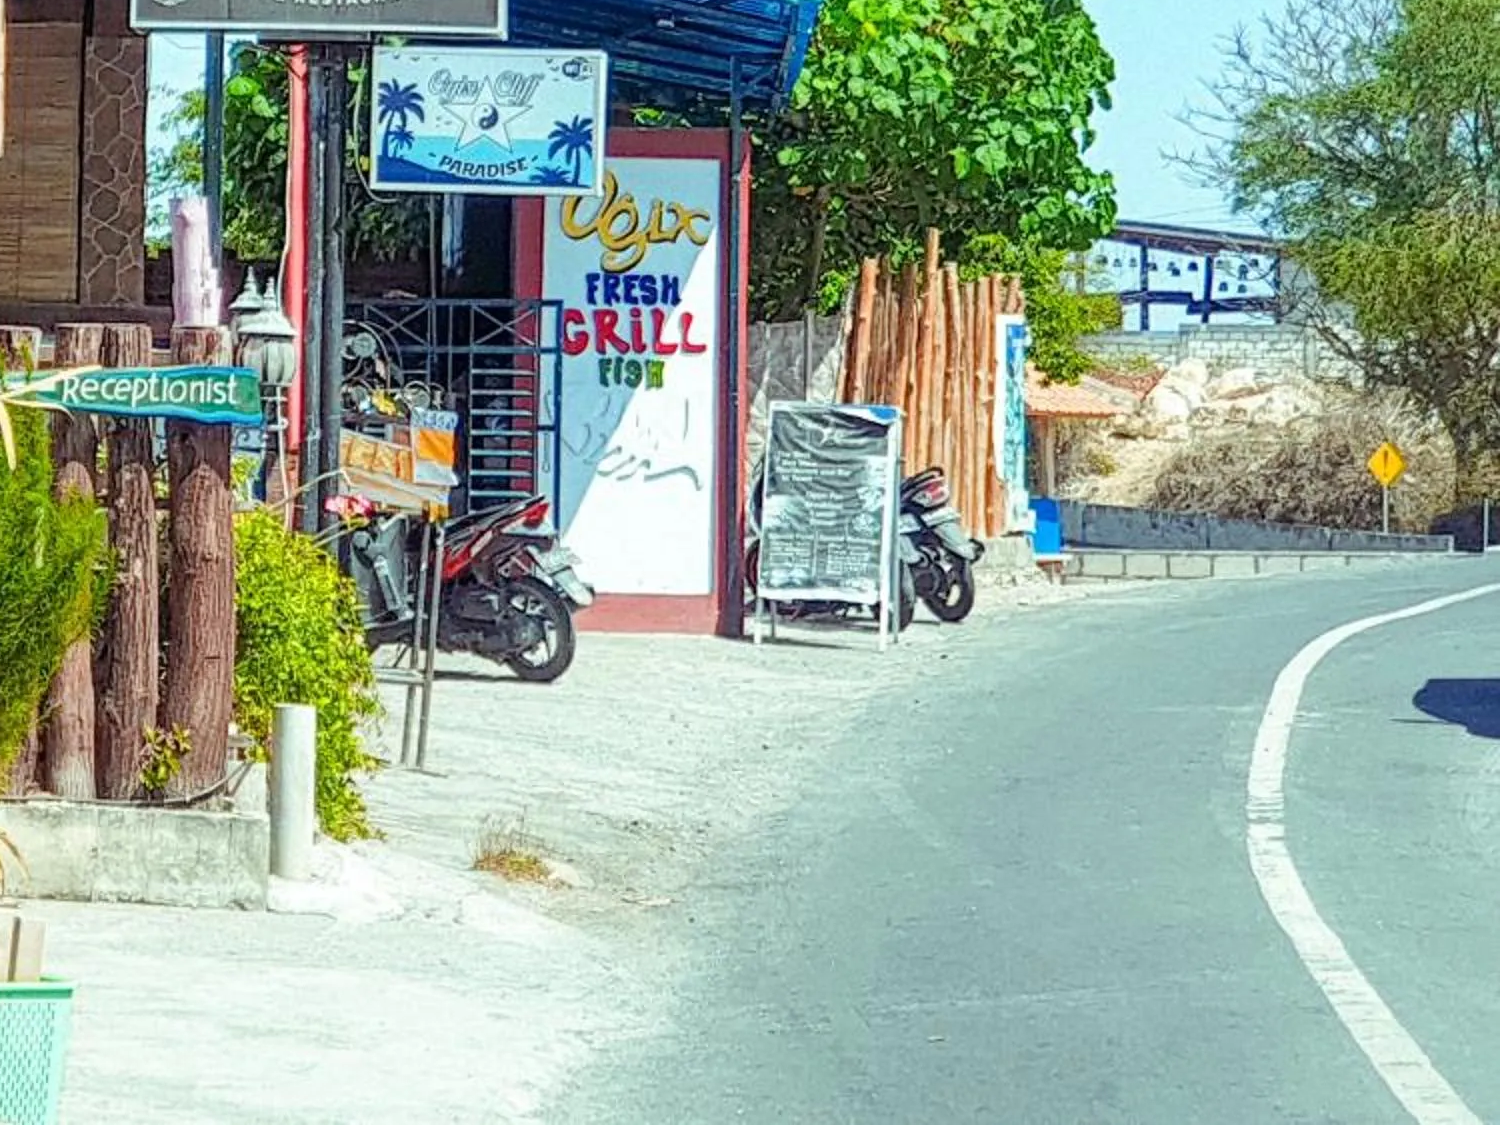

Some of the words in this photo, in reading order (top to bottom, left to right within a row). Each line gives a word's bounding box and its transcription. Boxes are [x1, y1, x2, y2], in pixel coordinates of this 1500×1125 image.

[438, 154, 529, 177] PARADISE
[585, 273, 682, 306] FRESH
[61, 372, 238, 408] Receptionist
